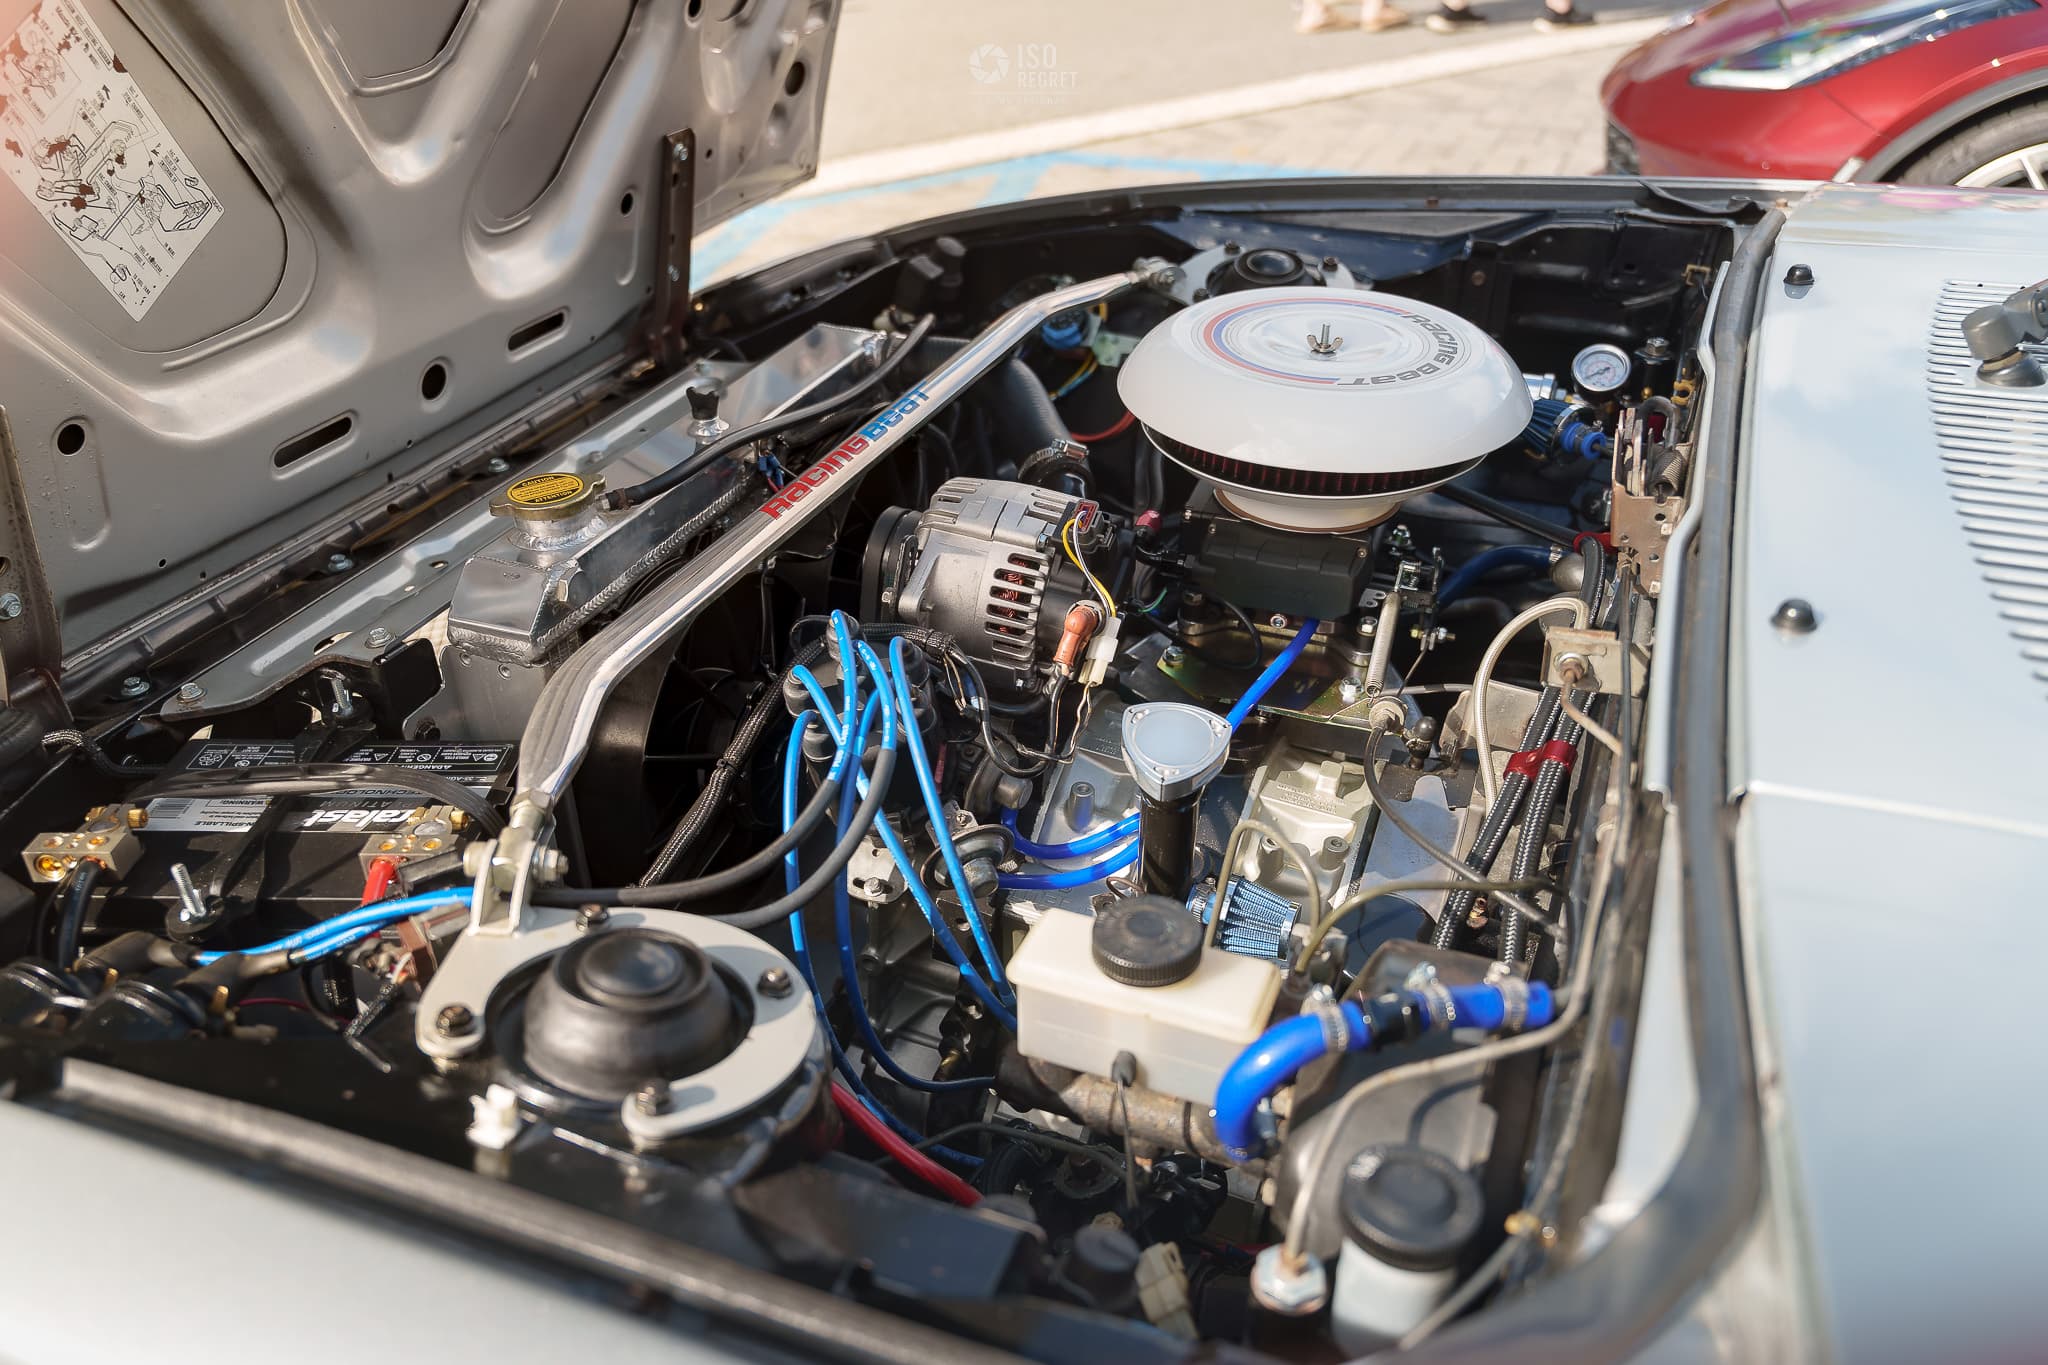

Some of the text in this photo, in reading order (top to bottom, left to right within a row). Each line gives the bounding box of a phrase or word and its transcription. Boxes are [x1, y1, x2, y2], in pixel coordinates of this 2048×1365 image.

[522, 476, 555, 487] CAUTION
[535, 490, 573, 503] ATTENTION
[303, 809, 416, 827] ralast
